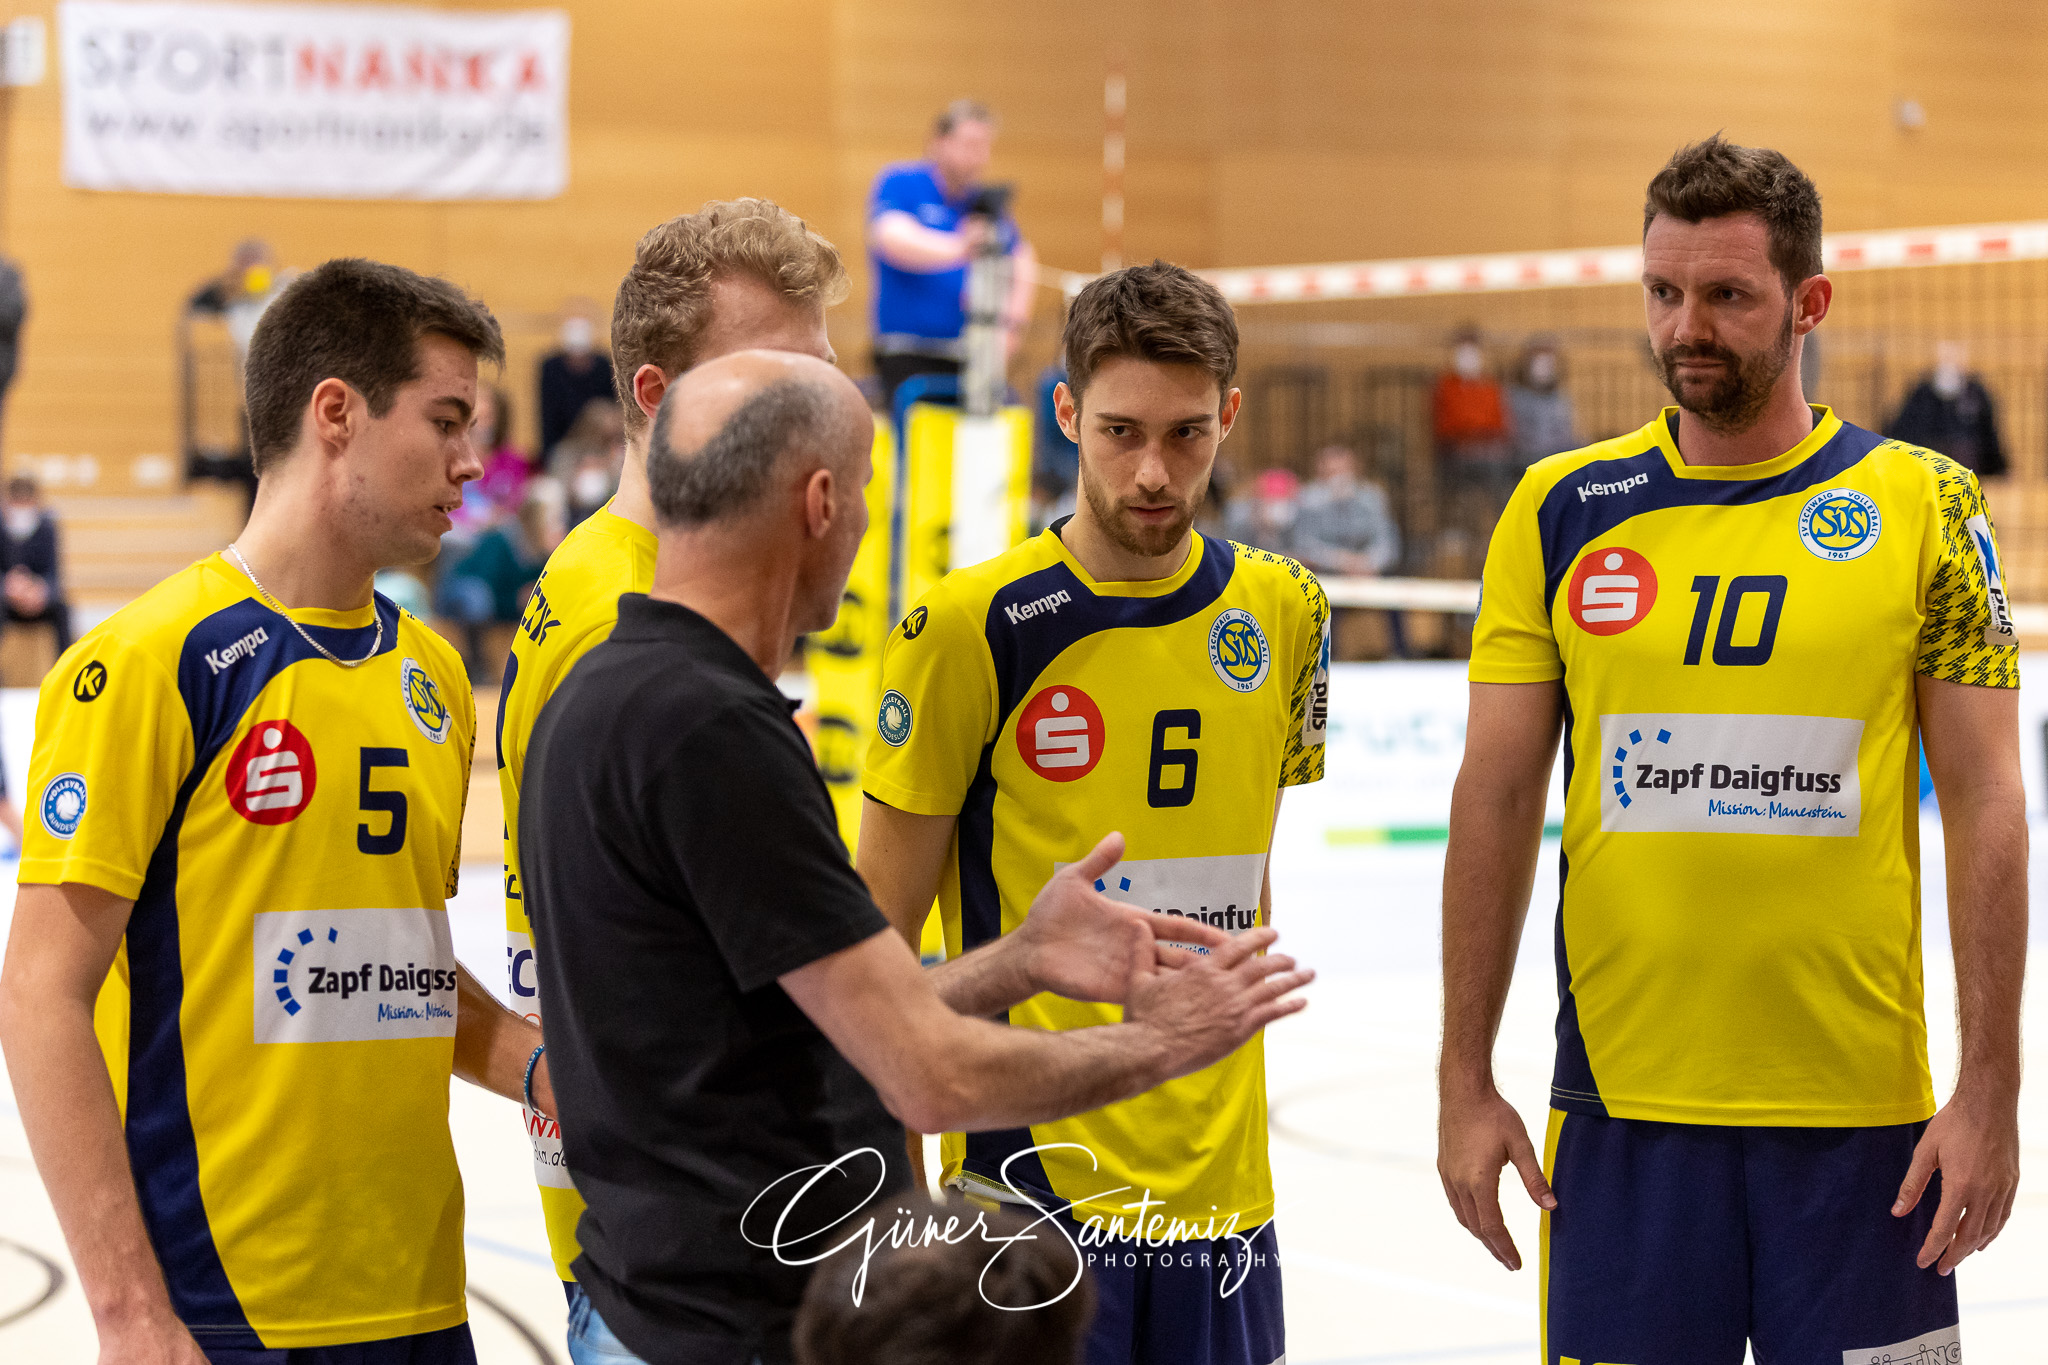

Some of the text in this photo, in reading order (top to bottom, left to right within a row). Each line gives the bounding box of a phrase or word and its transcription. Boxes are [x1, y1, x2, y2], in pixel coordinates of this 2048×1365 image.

[80, 29, 546, 93] SPORTNANKA
[1577, 472, 1649, 503] Kempa
[1802, 492, 1833, 523] SCHWAIG
[1848, 491, 1879, 538] VOLLEYBALL
[1827, 551, 1849, 559] 1967
[1004, 589, 1072, 625] Kempa
[1683, 575, 1788, 666] 10
[1989, 587, 2013, 637] puls
[205, 626, 270, 675] Kempa
[1211, 613, 1231, 651] SCHWAIG
[1240, 611, 1269, 664] VOLLEYBALL
[1237, 681, 1253, 690] 1967
[882, 696, 909, 718] VOLLEYBALL
[880, 720, 907, 741] BUNDESLIGA
[1147, 708, 1201, 808] 6
[1636, 763, 1841, 797] Zapf Daigfuss
[357, 747, 409, 855] 5
[1708, 799, 1847, 819] Mission: Mauerstein
[308, 963, 373, 999] Zapf
